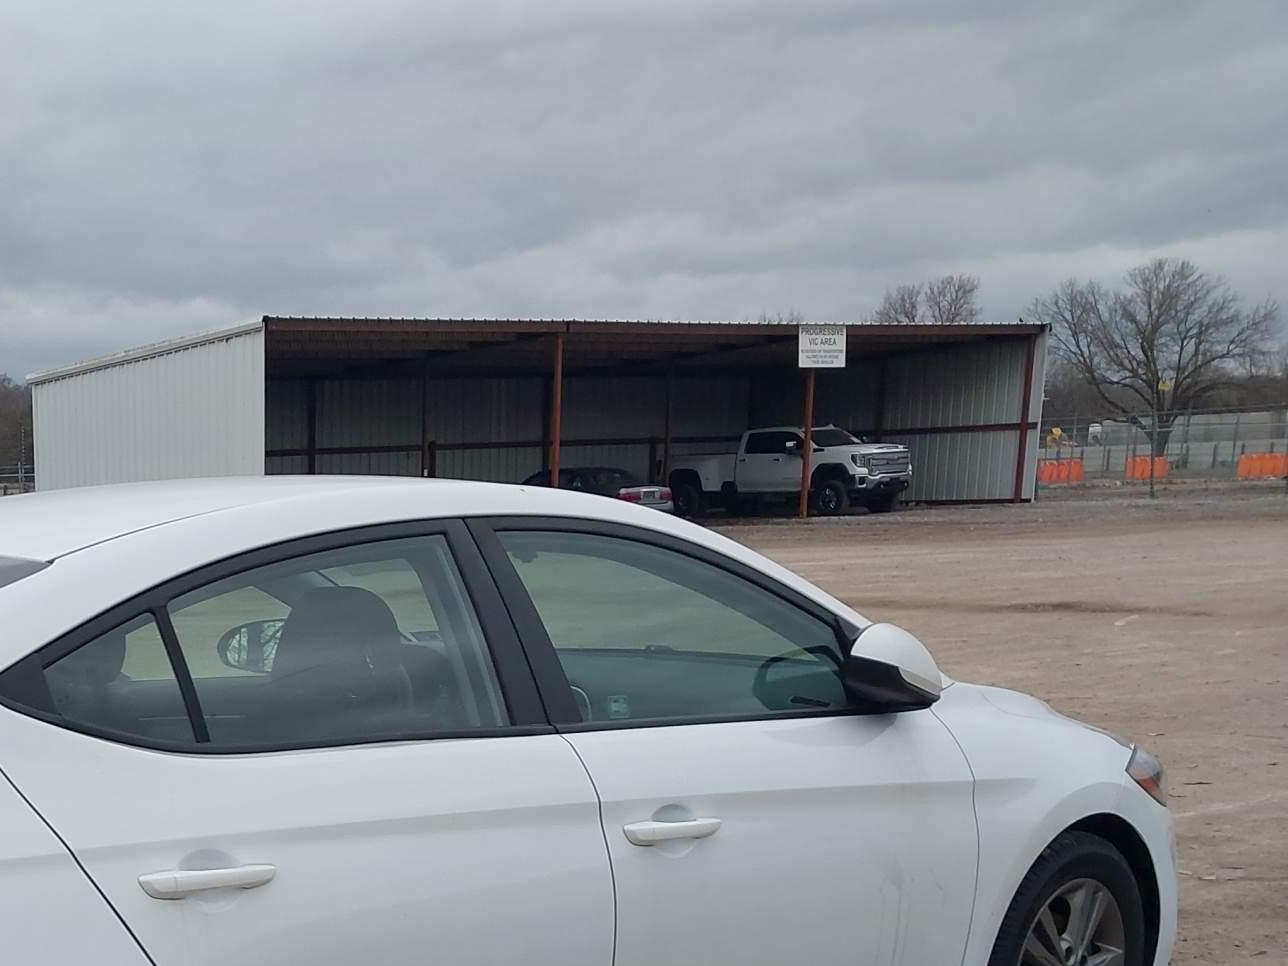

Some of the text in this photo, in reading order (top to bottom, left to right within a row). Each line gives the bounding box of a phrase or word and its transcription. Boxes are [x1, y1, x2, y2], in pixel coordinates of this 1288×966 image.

[801, 327, 844, 336] PROGRESSIVE
[809, 337, 837, 346] VIC AREA
